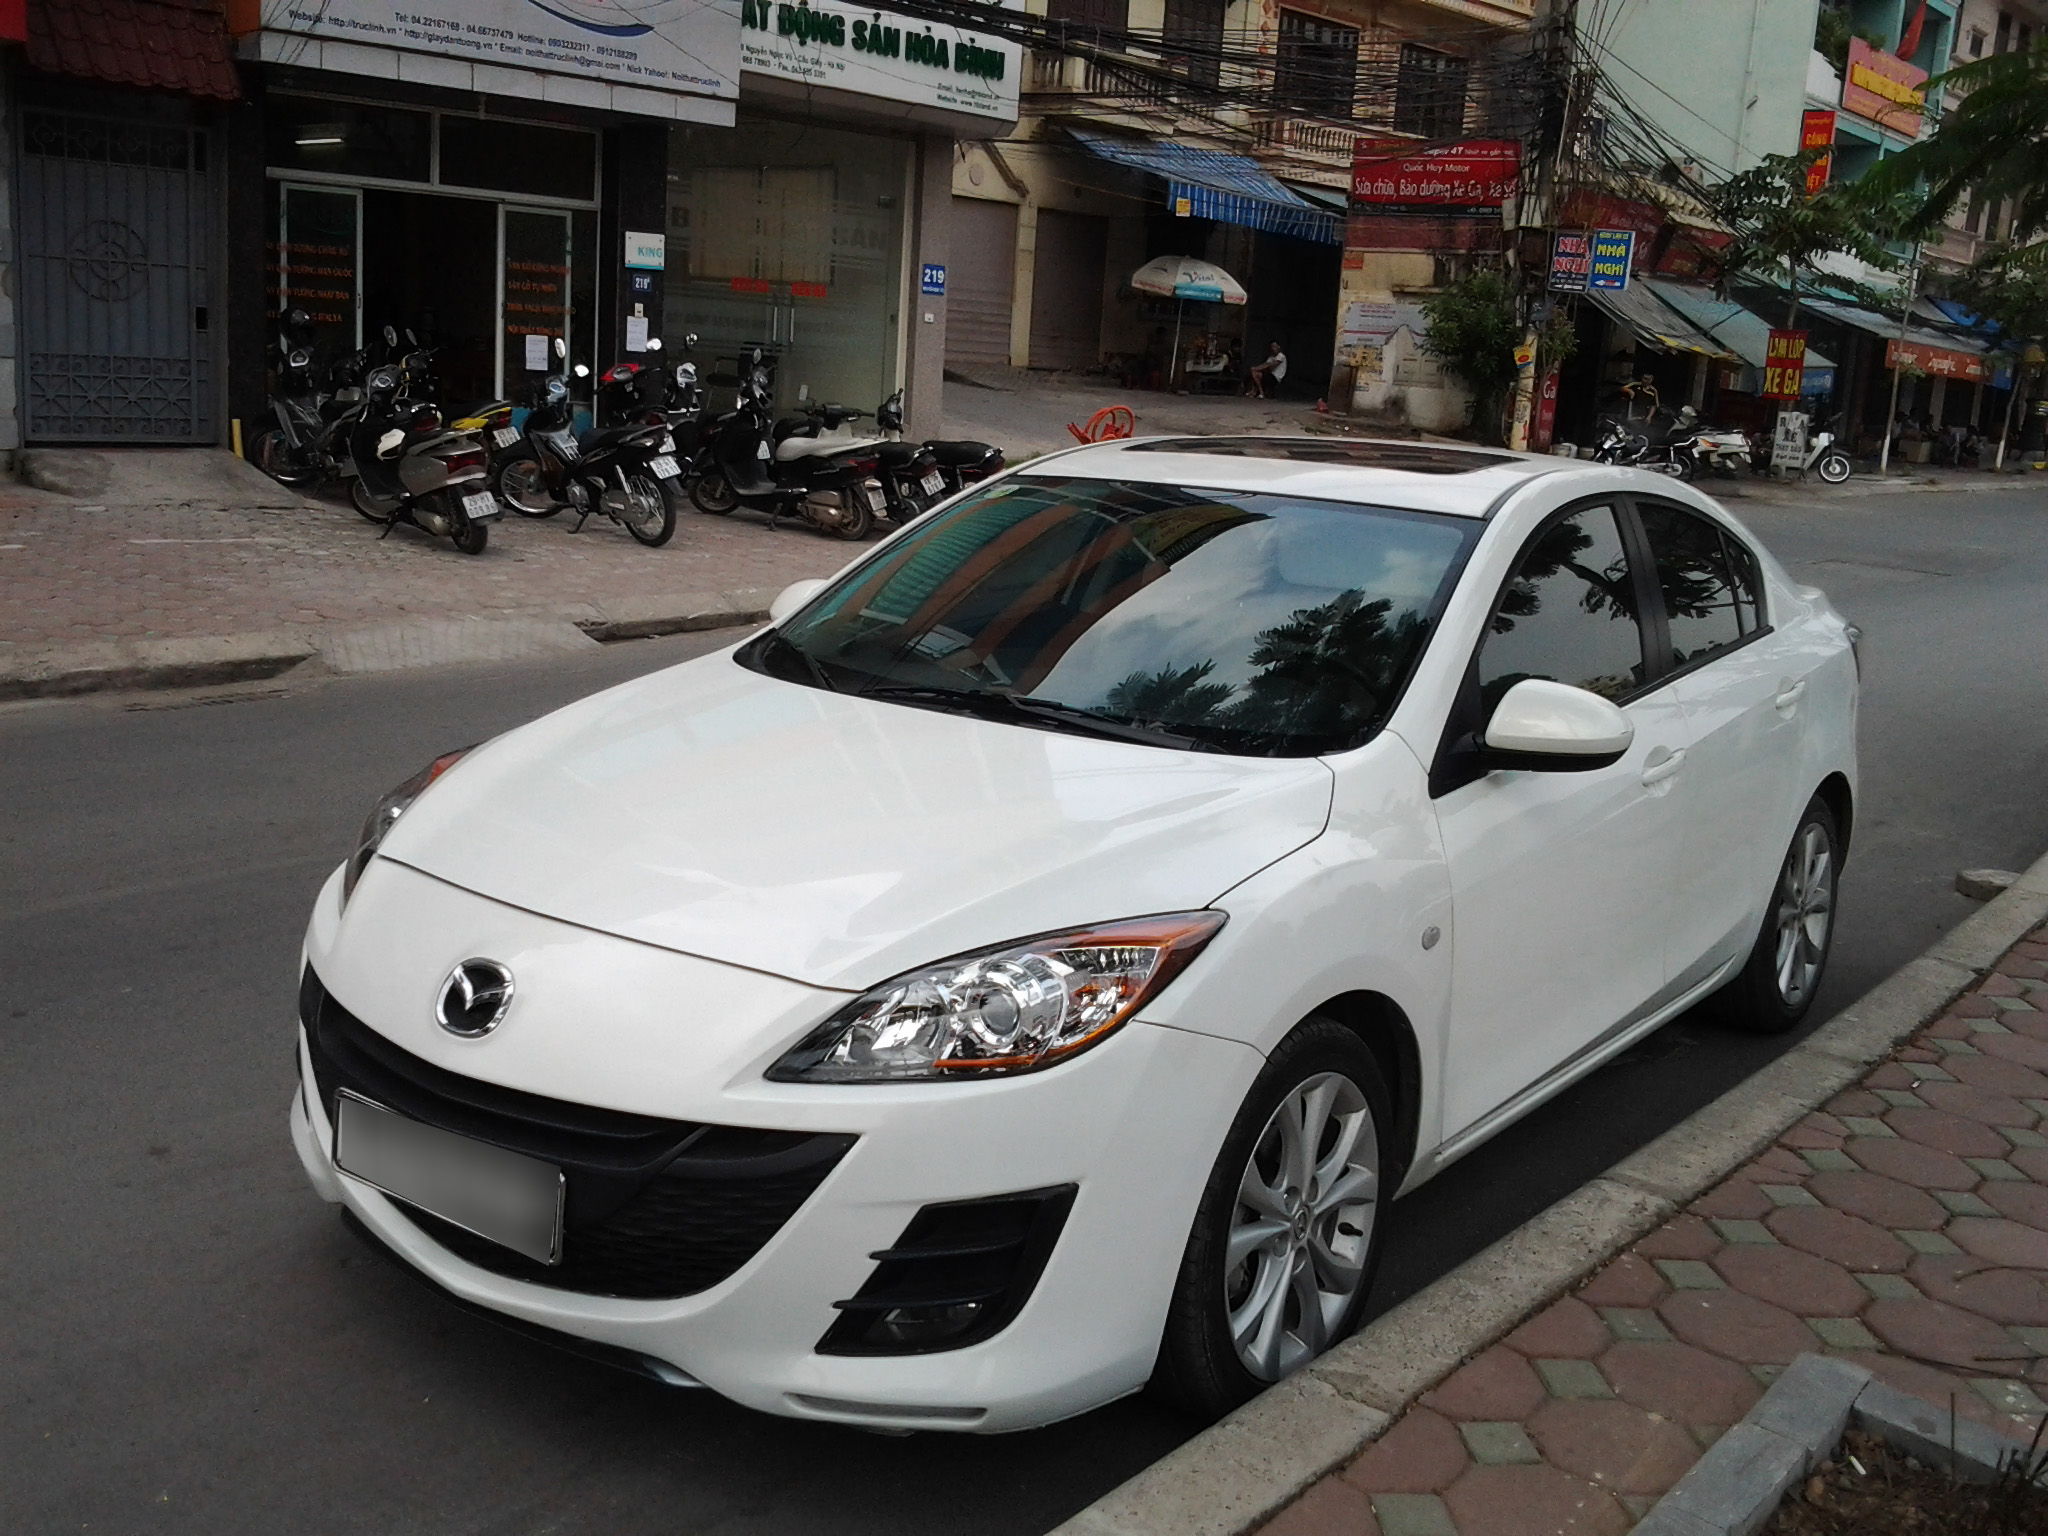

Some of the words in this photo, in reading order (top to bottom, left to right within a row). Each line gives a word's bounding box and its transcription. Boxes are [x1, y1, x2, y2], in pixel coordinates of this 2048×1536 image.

[851, 12, 900, 58] SẢN
[905, 25, 949, 70] HÒA
[955, 37, 1005, 80] BÌNH
[627, 65, 642, 76] Nick
[1451, 147, 1463, 155] 4T
[1403, 161, 1424, 173] Quốc
[1427, 163, 1443, 174] Huy
[1445, 163, 1470, 173] Motor
[1400, 177, 1417, 196] Bảo
[637, 246, 663, 258] KING
[1596, 242, 1626, 258] NHÀ
[923, 268, 945, 284] 219
[1763, 367, 1782, 394] XE
[1783, 368, 1800, 396] GA
